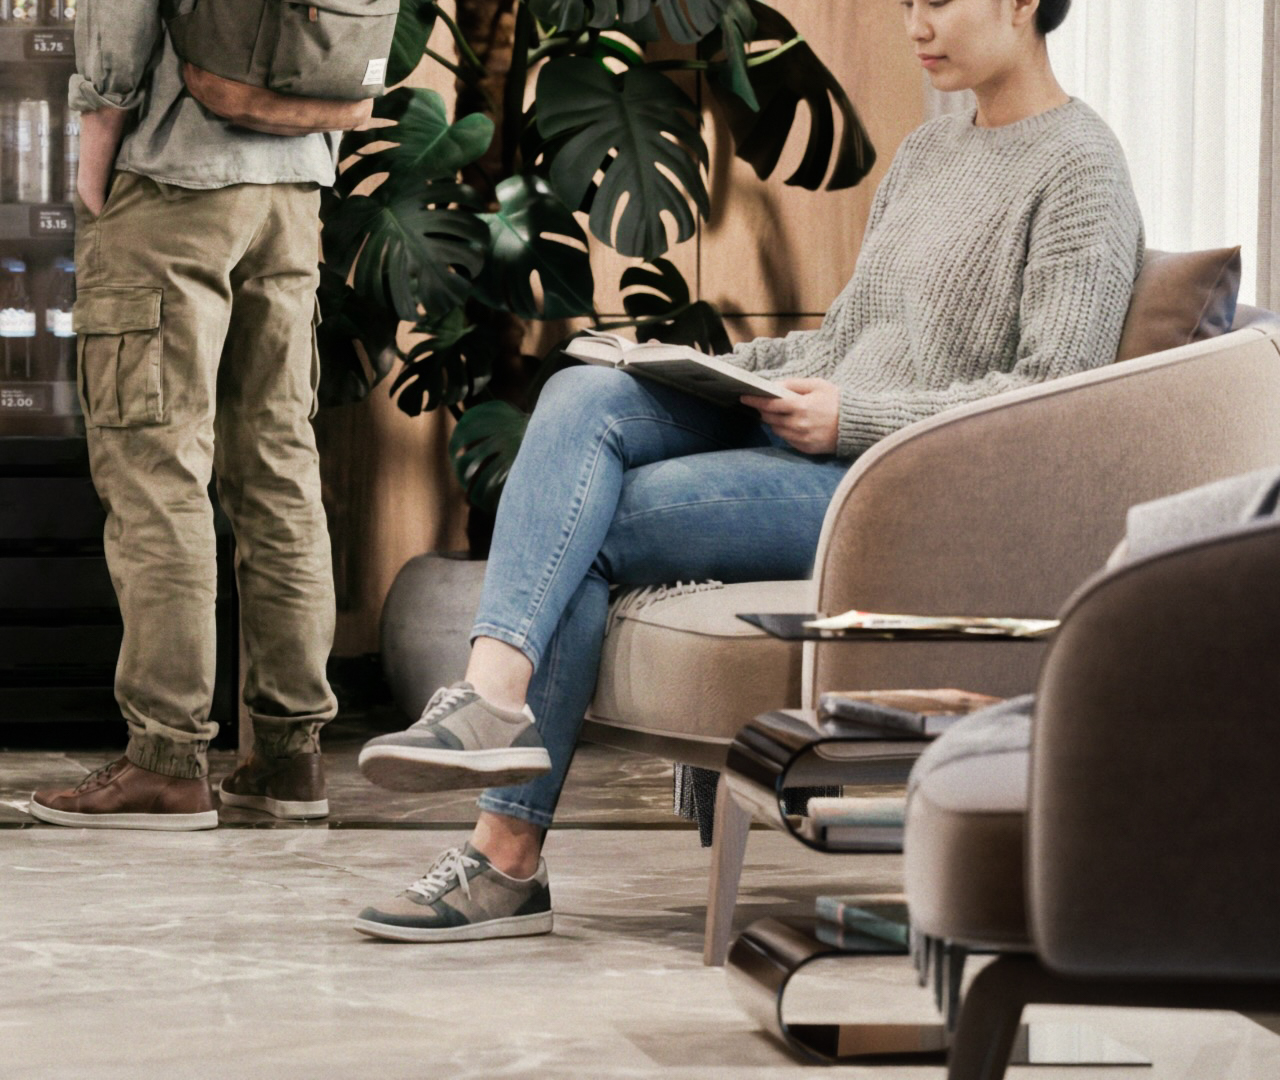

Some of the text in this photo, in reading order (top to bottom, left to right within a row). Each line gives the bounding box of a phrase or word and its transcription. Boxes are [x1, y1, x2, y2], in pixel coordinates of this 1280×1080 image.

[34, 42, 64, 52] $3.75
[40, 219, 67, 229] $3.15
[1, 398, 33, 407] $2.00
